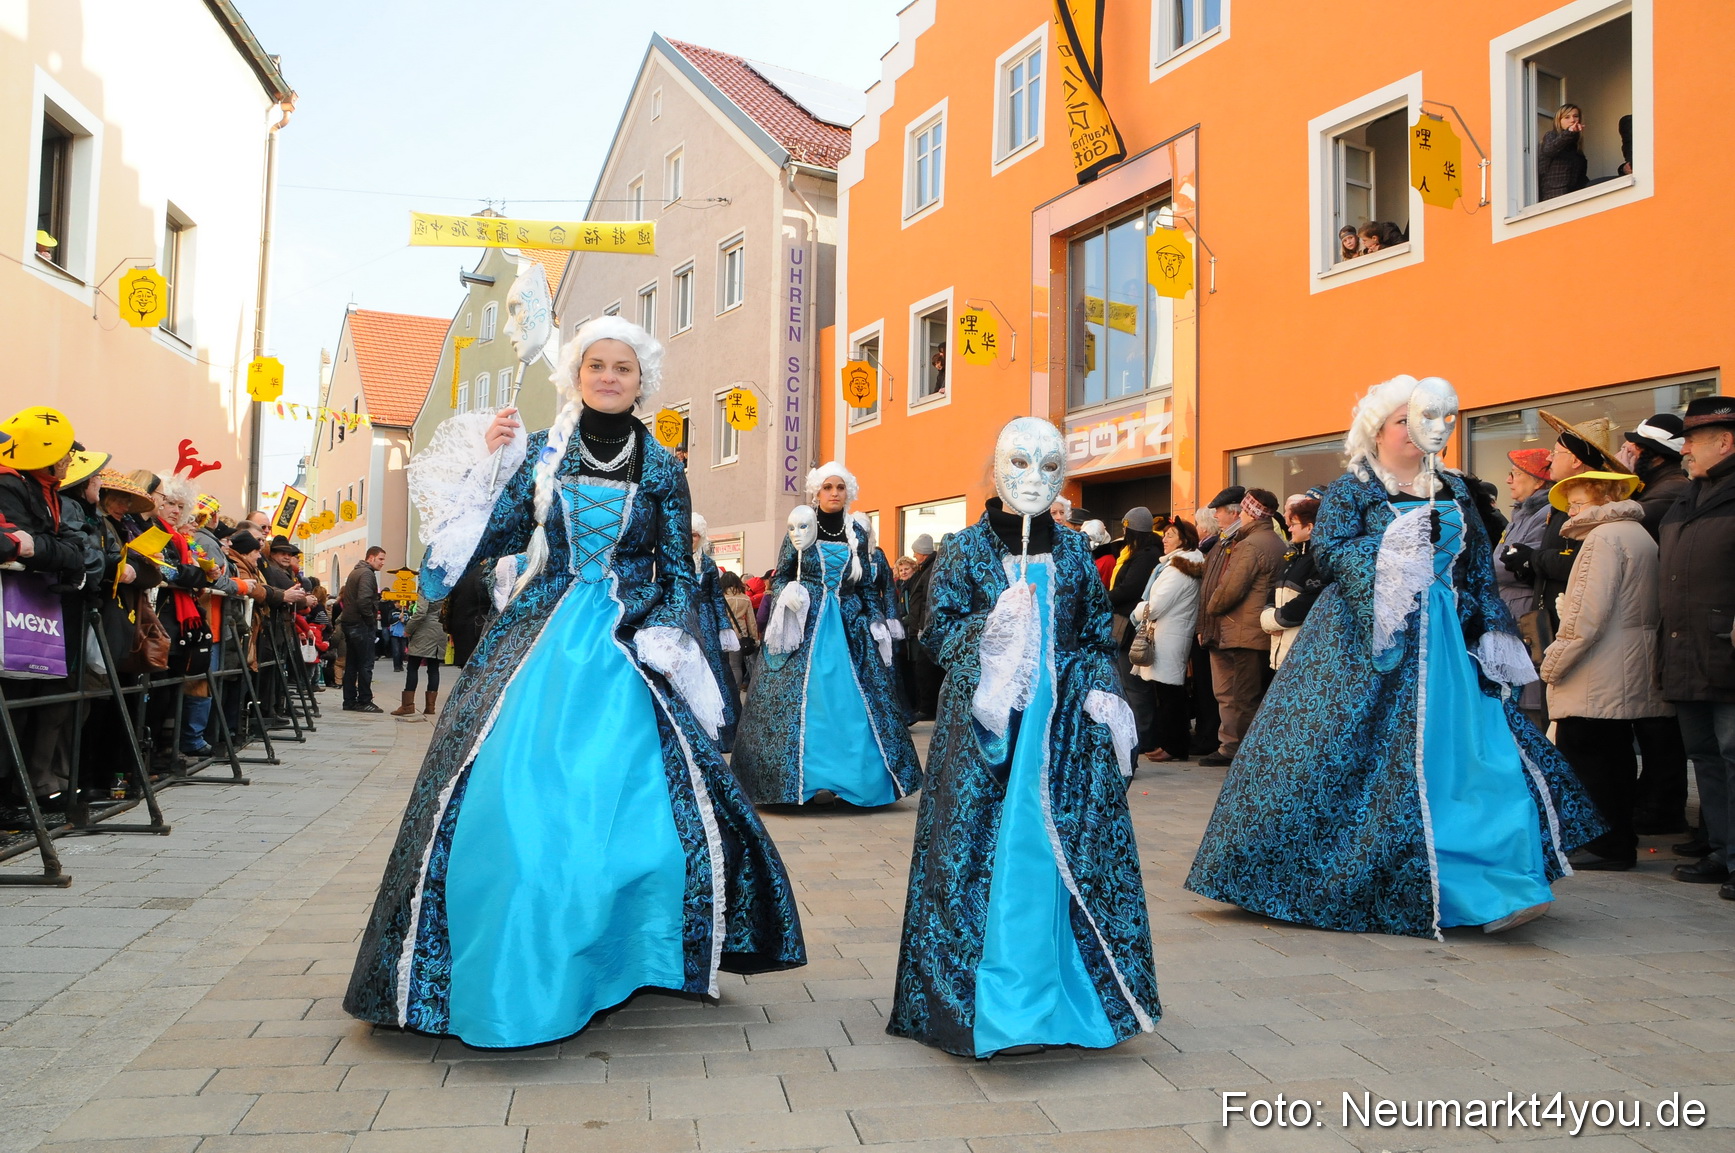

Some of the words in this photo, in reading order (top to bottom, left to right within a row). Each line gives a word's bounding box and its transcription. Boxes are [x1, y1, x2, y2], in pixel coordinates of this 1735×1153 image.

[1443, 160, 1456, 181] 华
[1419, 175, 1430, 193] 人
[790, 248, 803, 342] UHREN
[963, 339, 976, 355] 人
[981, 331, 996, 351] 华
[730, 411, 741, 423] 人
[745, 405, 757, 420] 华
[784, 356, 800, 493] SCHMUCK
[1064, 410, 1173, 462] GÖTZ
